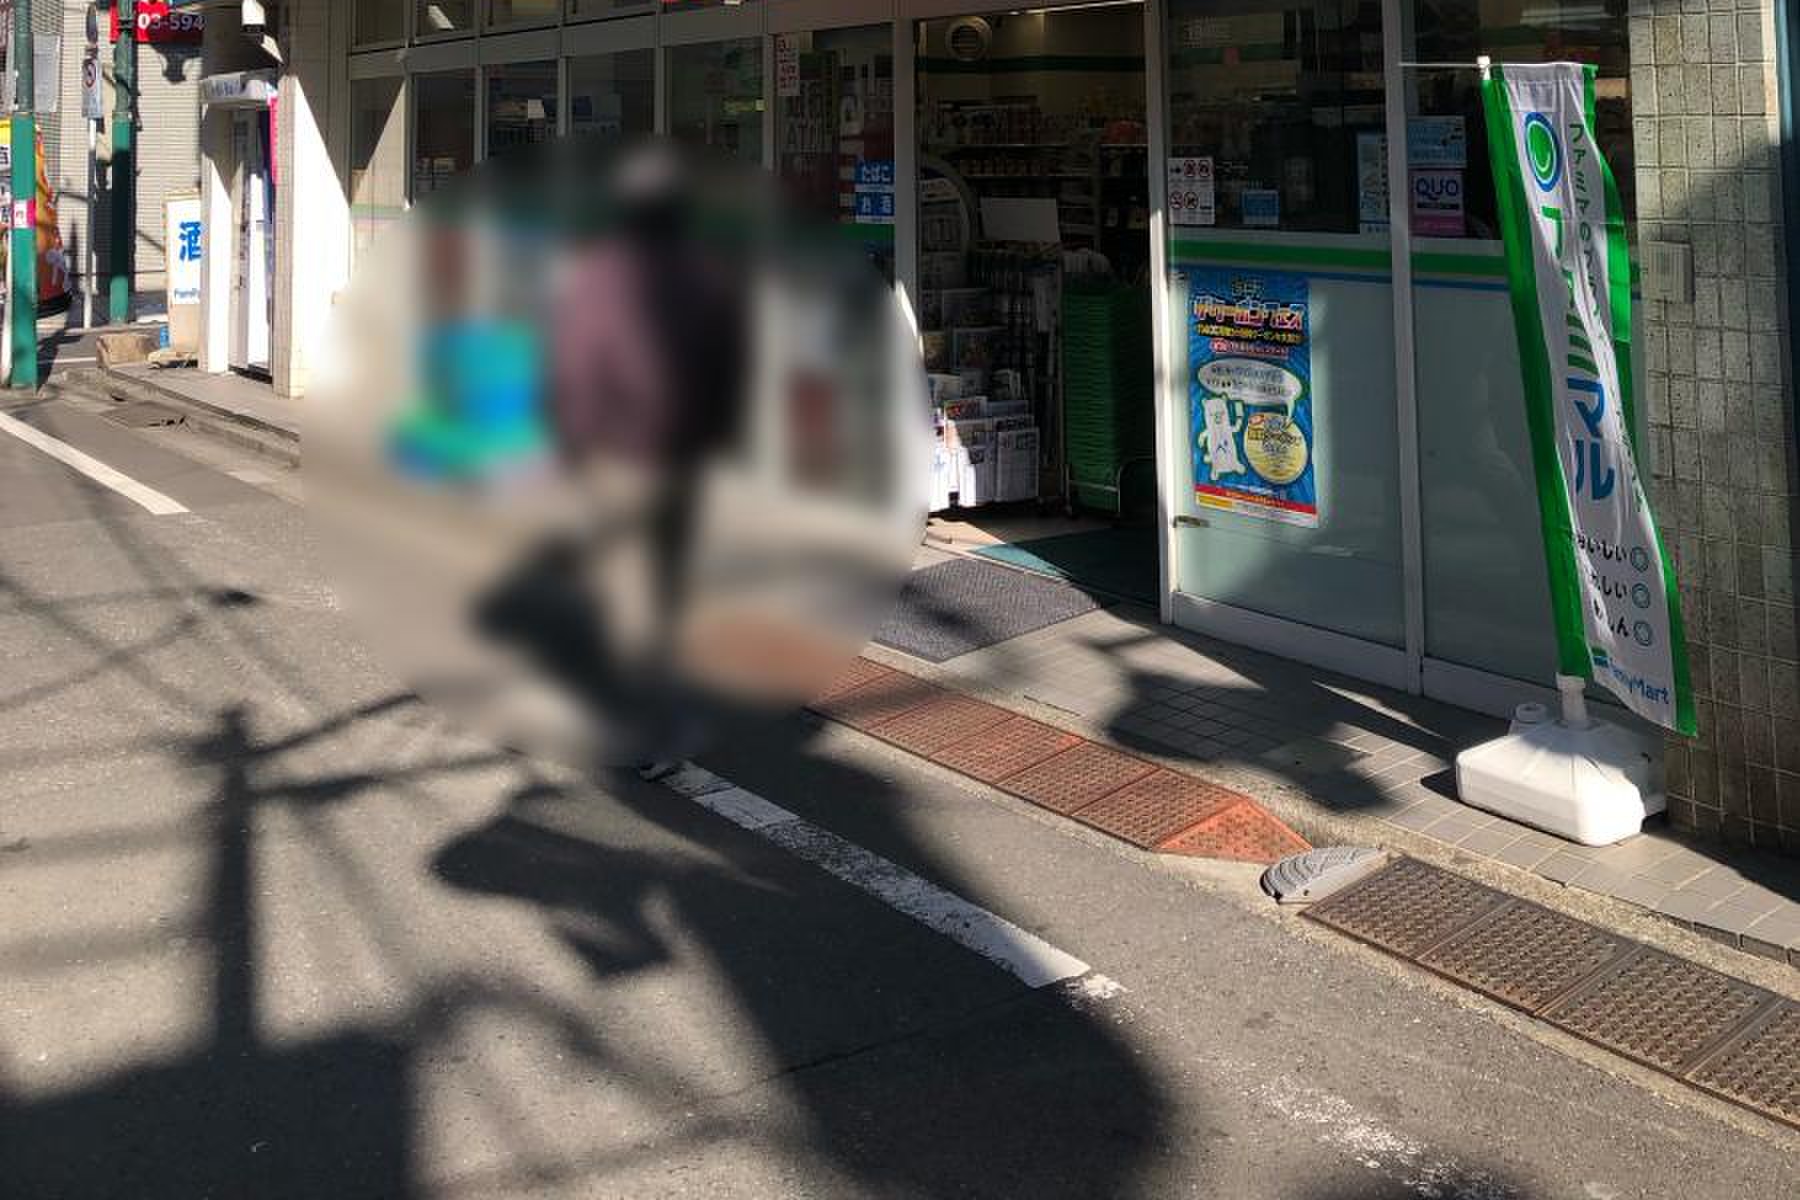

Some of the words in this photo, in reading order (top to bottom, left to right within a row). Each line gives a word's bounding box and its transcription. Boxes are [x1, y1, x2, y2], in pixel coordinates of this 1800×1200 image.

[861, 161, 892, 183] たばこ
[1416, 176, 1458, 200] QUO
